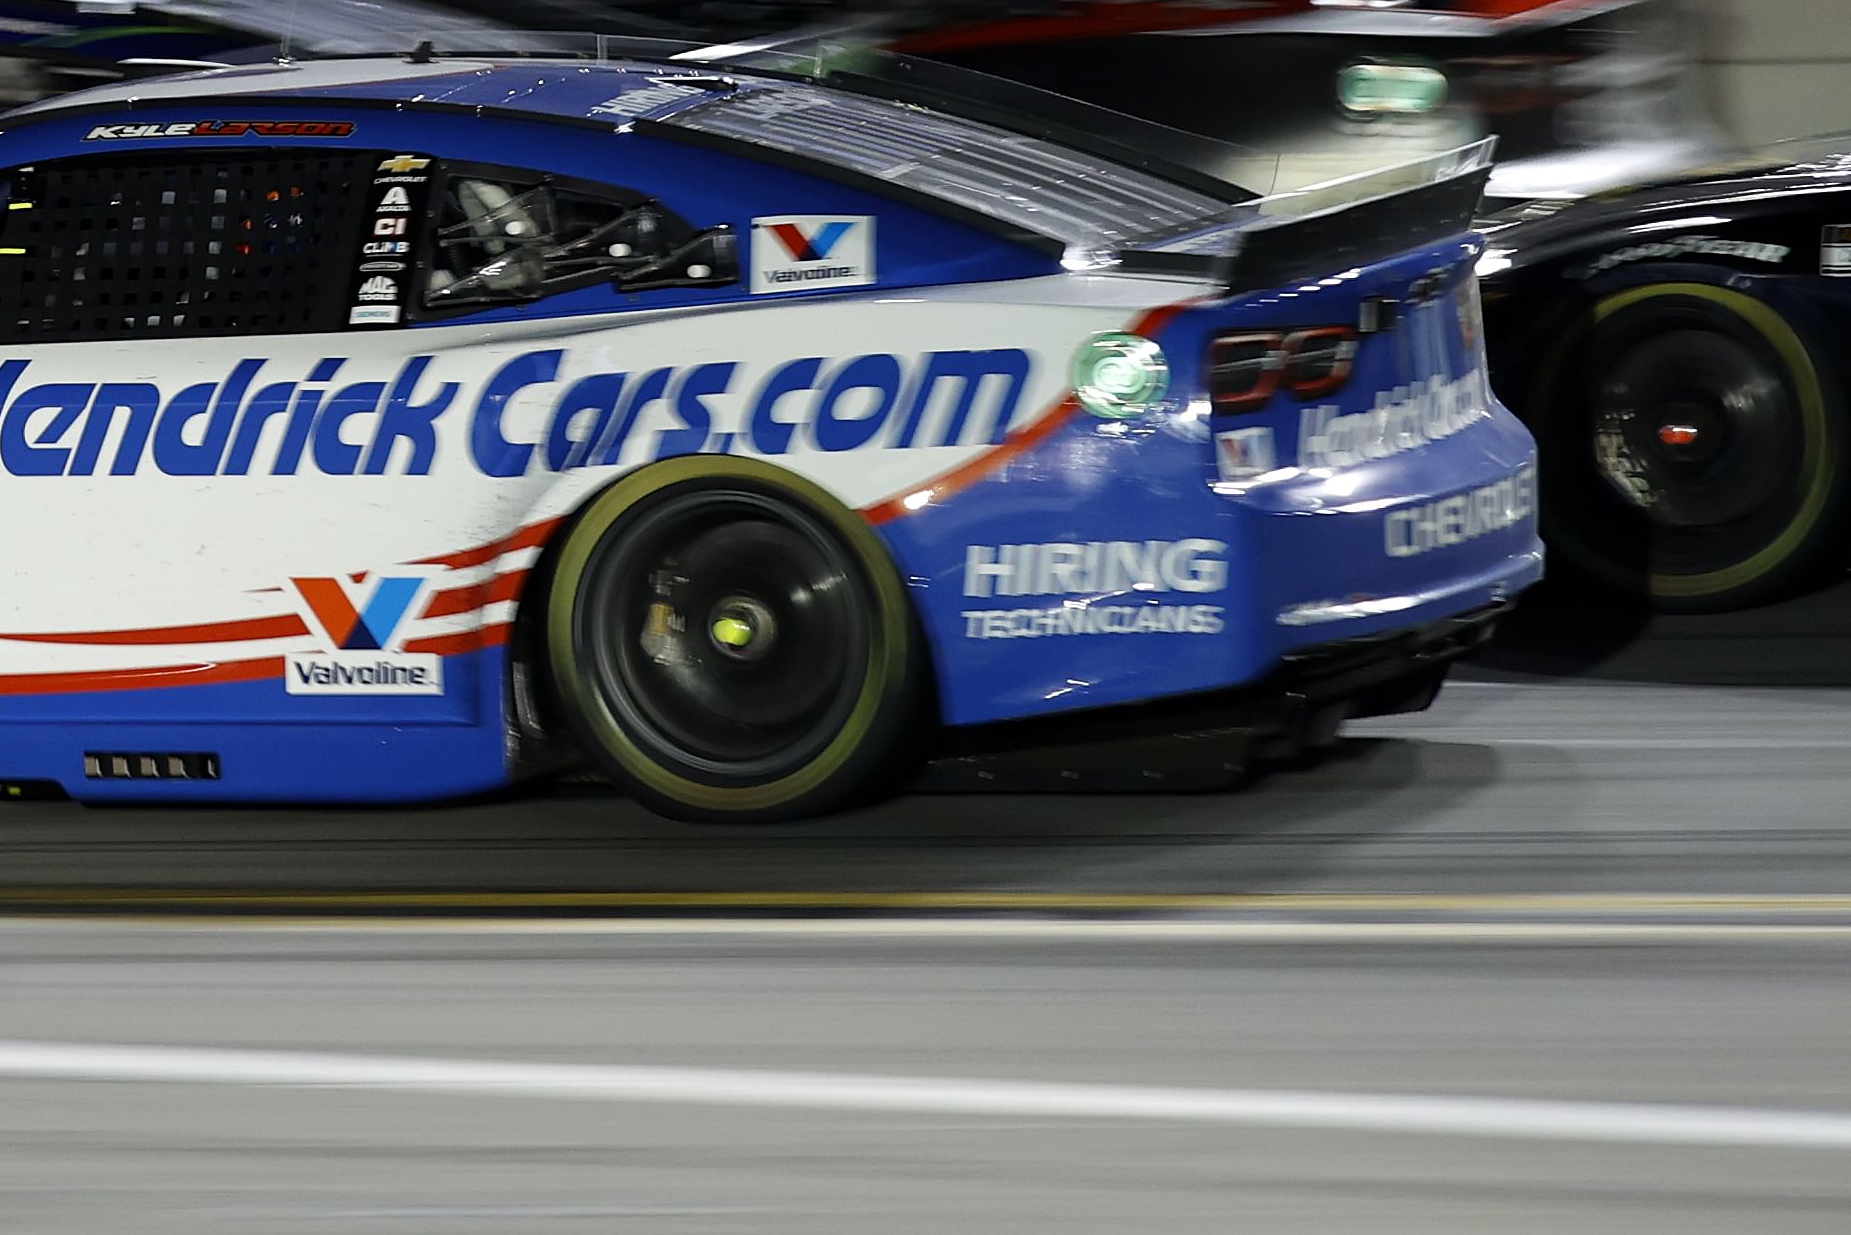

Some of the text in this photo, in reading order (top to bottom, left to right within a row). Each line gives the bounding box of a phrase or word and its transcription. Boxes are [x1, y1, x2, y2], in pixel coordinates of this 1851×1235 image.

[963, 538, 1229, 597] HIRING
[961, 605, 1225, 639] TECHNICIANS
[294, 660, 426, 685] Valvoline
